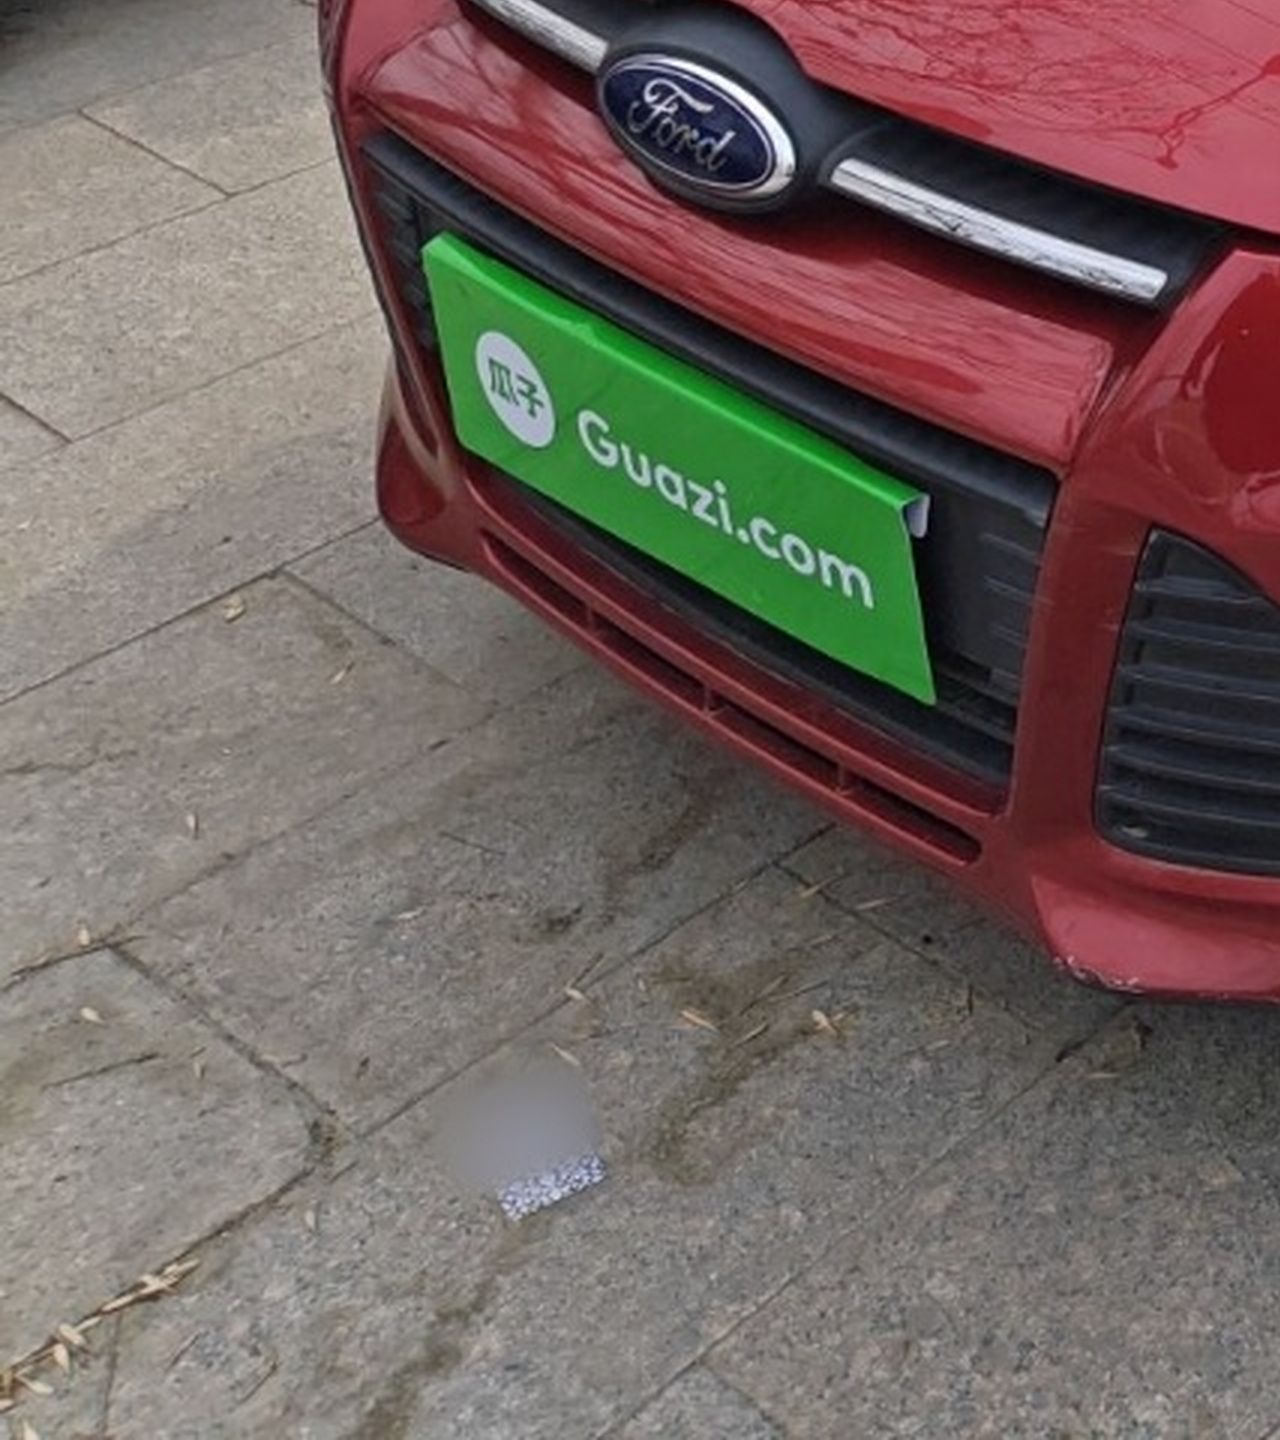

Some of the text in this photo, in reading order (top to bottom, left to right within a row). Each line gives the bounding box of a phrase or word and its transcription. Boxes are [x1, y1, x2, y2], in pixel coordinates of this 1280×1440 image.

[627, 78, 736, 171] Ford
[489, 357, 545, 418] 瓜子
[577, 409, 875, 610] Guazi.com
